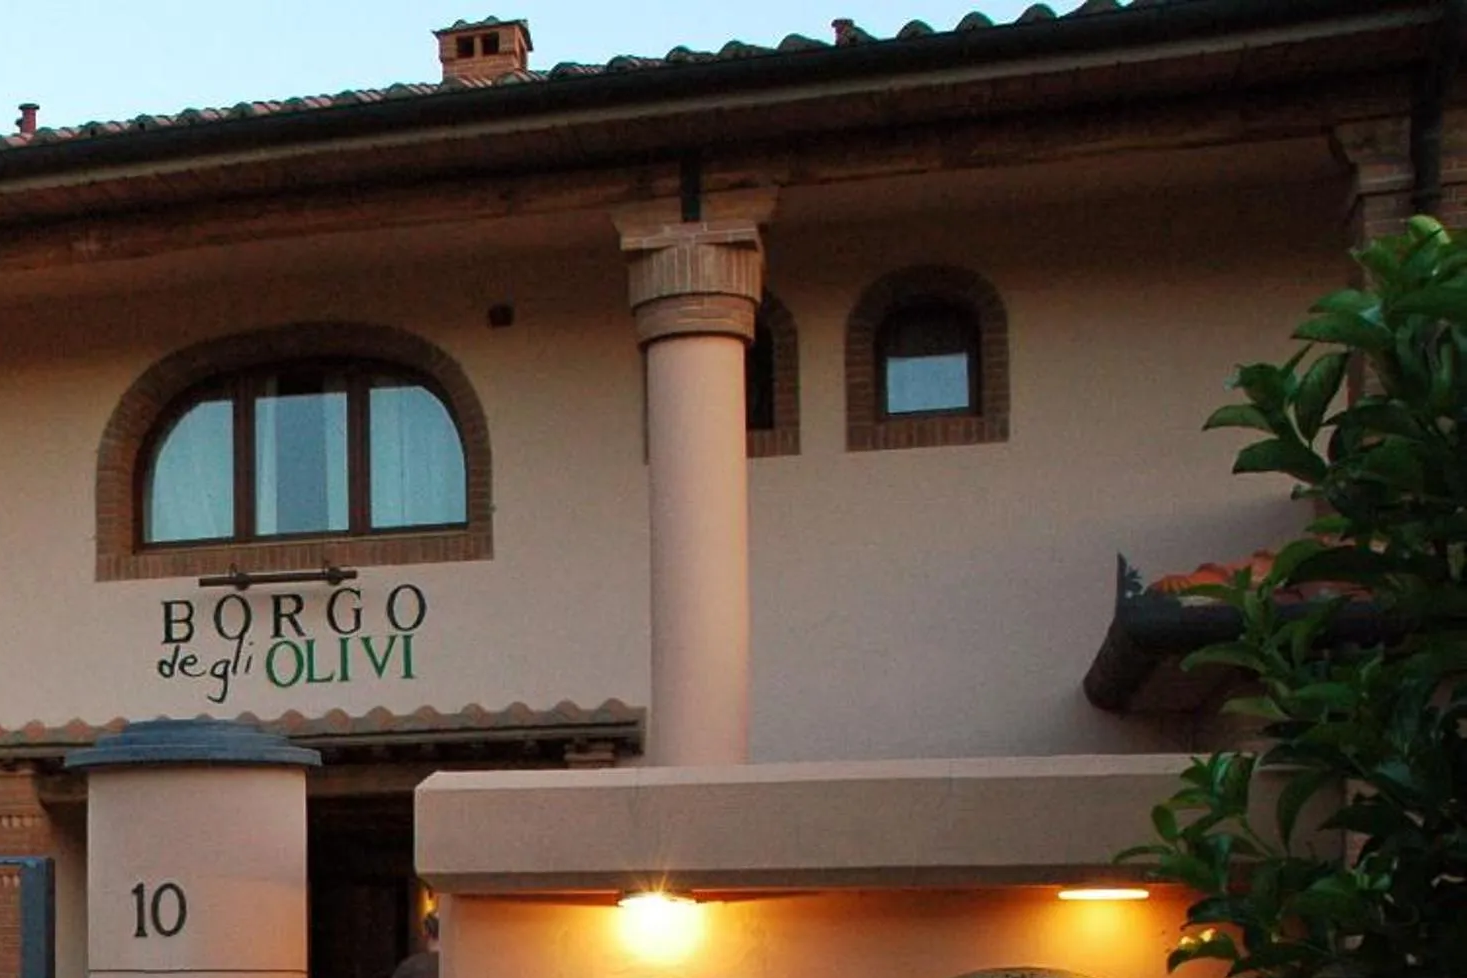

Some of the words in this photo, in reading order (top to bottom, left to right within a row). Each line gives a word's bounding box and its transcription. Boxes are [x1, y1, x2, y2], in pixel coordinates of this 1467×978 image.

[161, 583, 427, 645] BORGO
[156, 632, 254, 704] degli
[266, 634, 415, 688] OLIVI
[131, 881, 187, 938] 10
